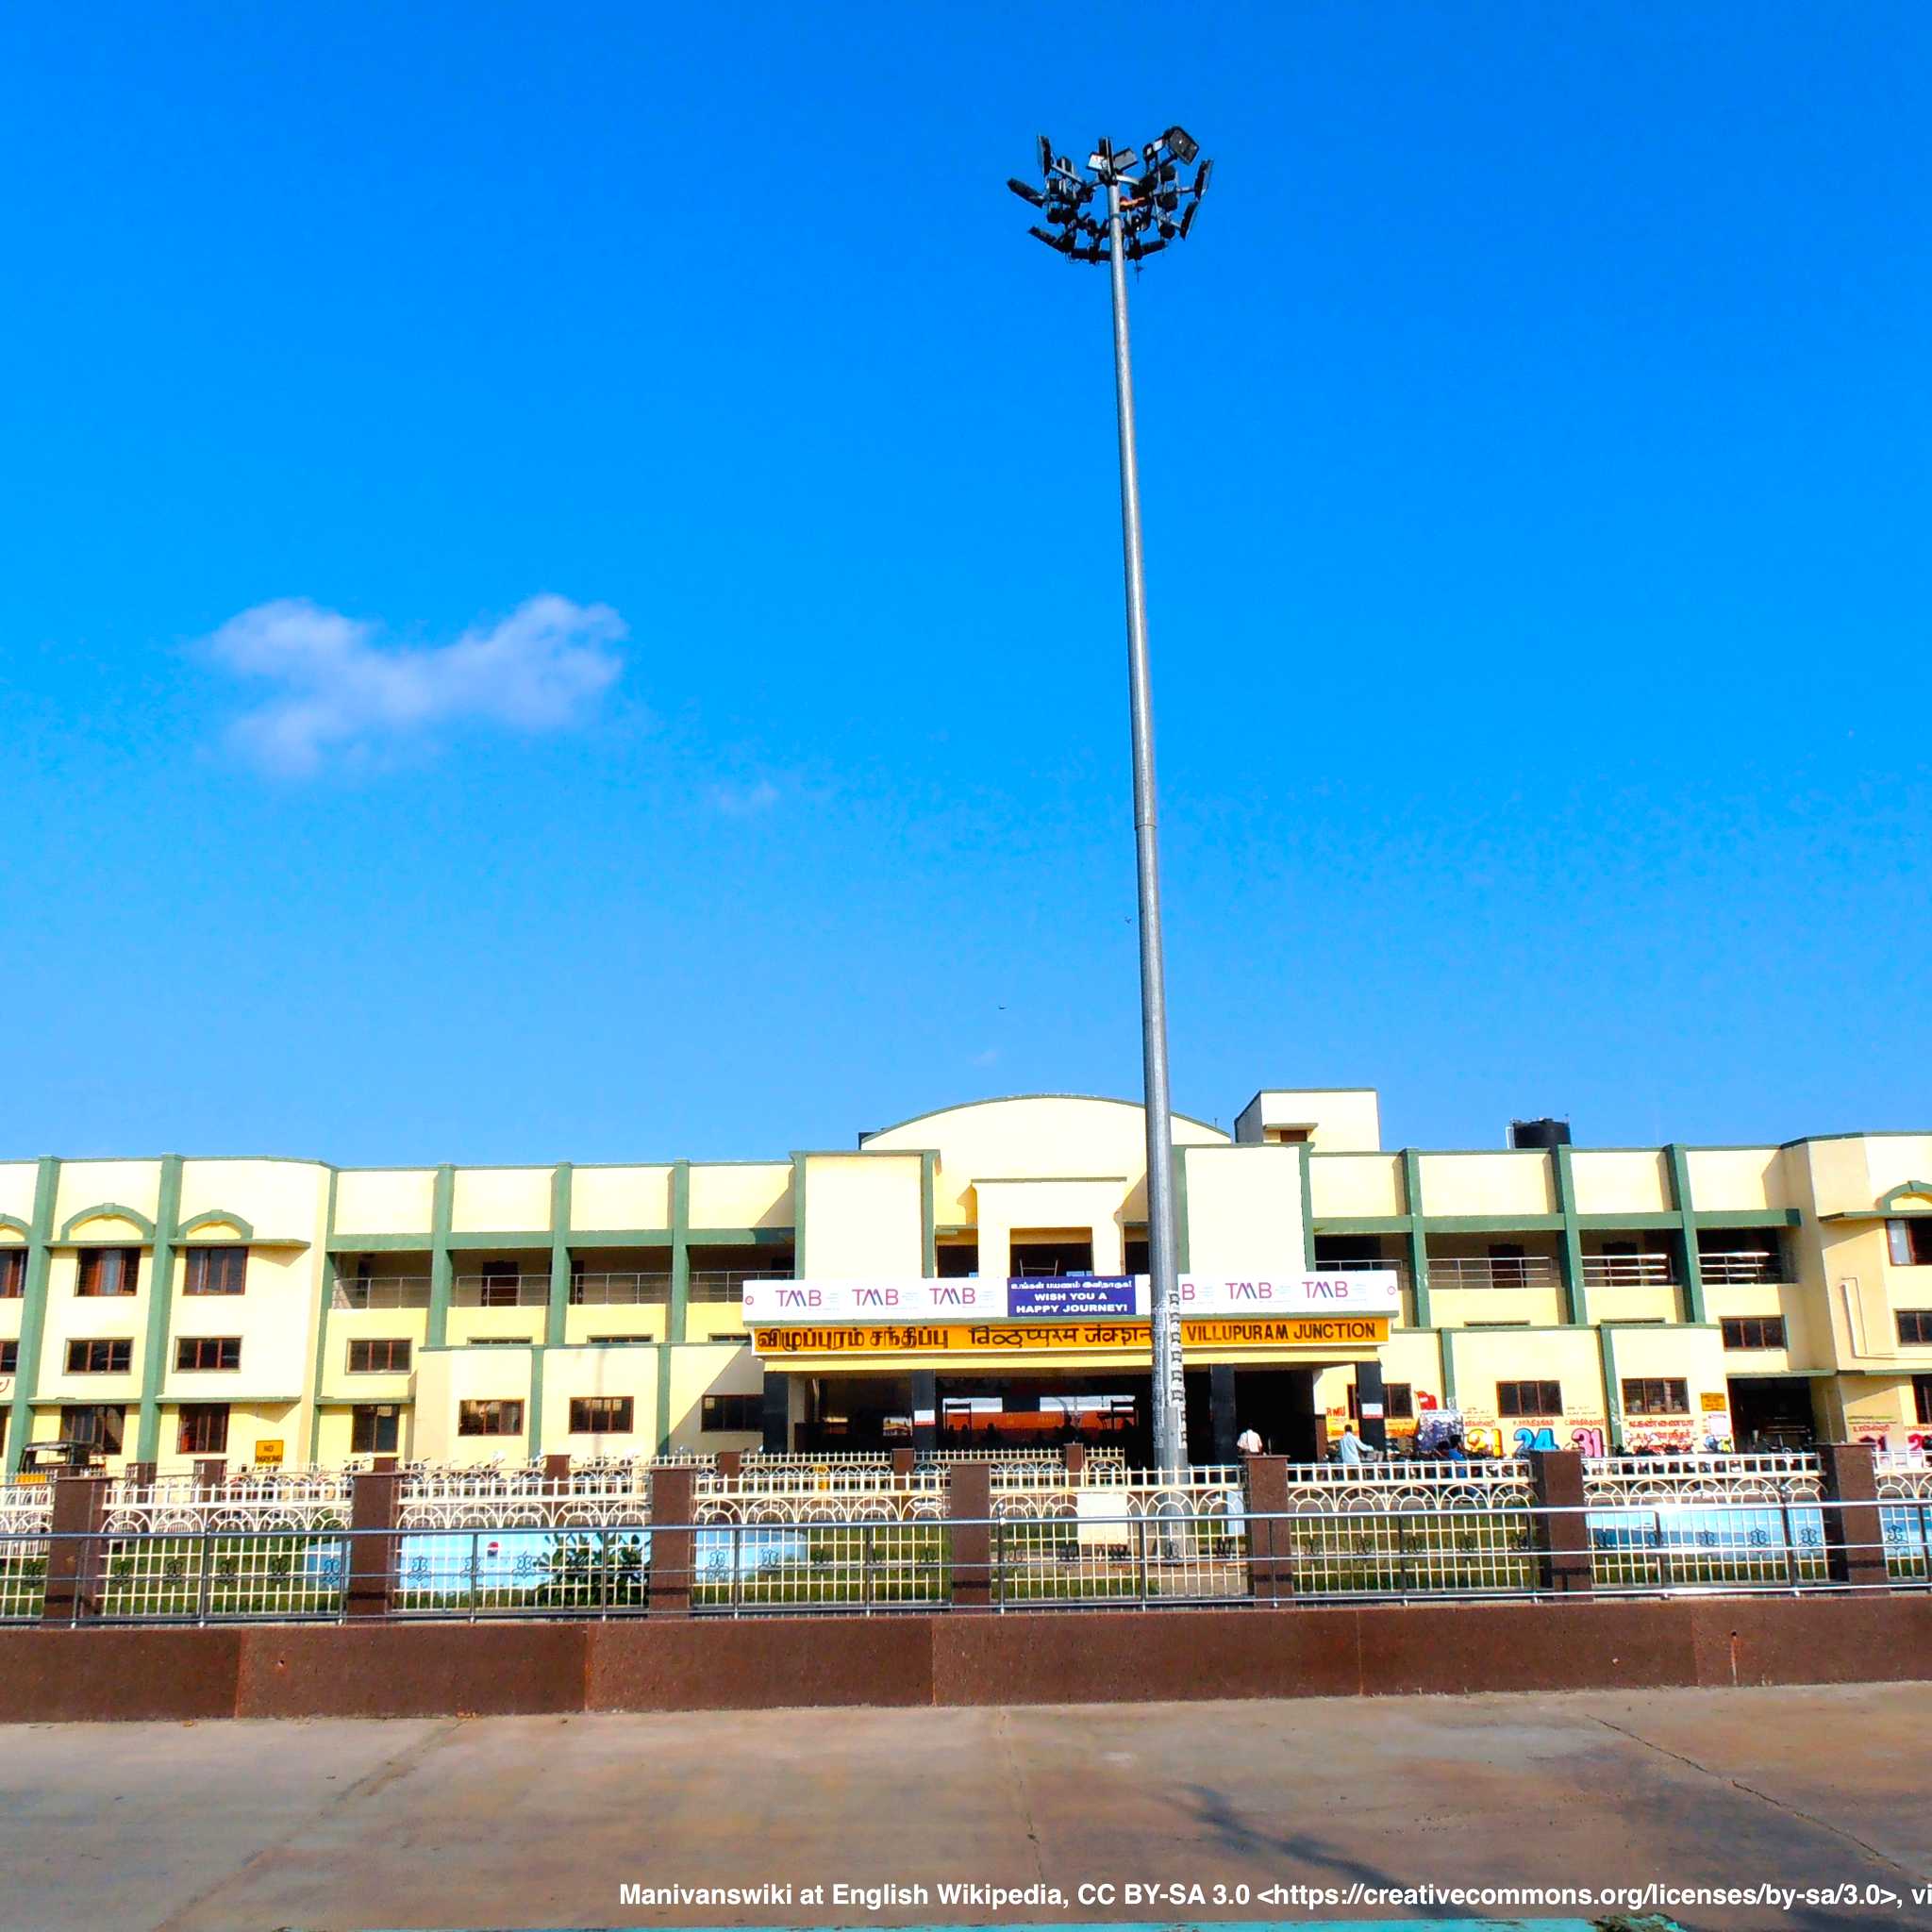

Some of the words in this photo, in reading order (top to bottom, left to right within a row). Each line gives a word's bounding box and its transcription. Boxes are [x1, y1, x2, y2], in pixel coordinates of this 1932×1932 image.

[852, 1289, 899, 1307] TMB
[929, 1288, 975, 1305] TMB
[1225, 1282, 1273, 1299] TMB
[1302, 1281, 1349, 1298] TMB
[775, 1290, 822, 1307] TMB
[1016, 1305, 1058, 1313] HAPPY
[1062, 1304, 1127, 1312] JOURNEY!
[758, 1327, 865, 1352] விழுப்புரம்
[870, 1326, 949, 1350] சந்திப்பு
[1187, 1324, 1289, 1341] VILLUPURAM
[1293, 1323, 1376, 1340] JUNCTION
